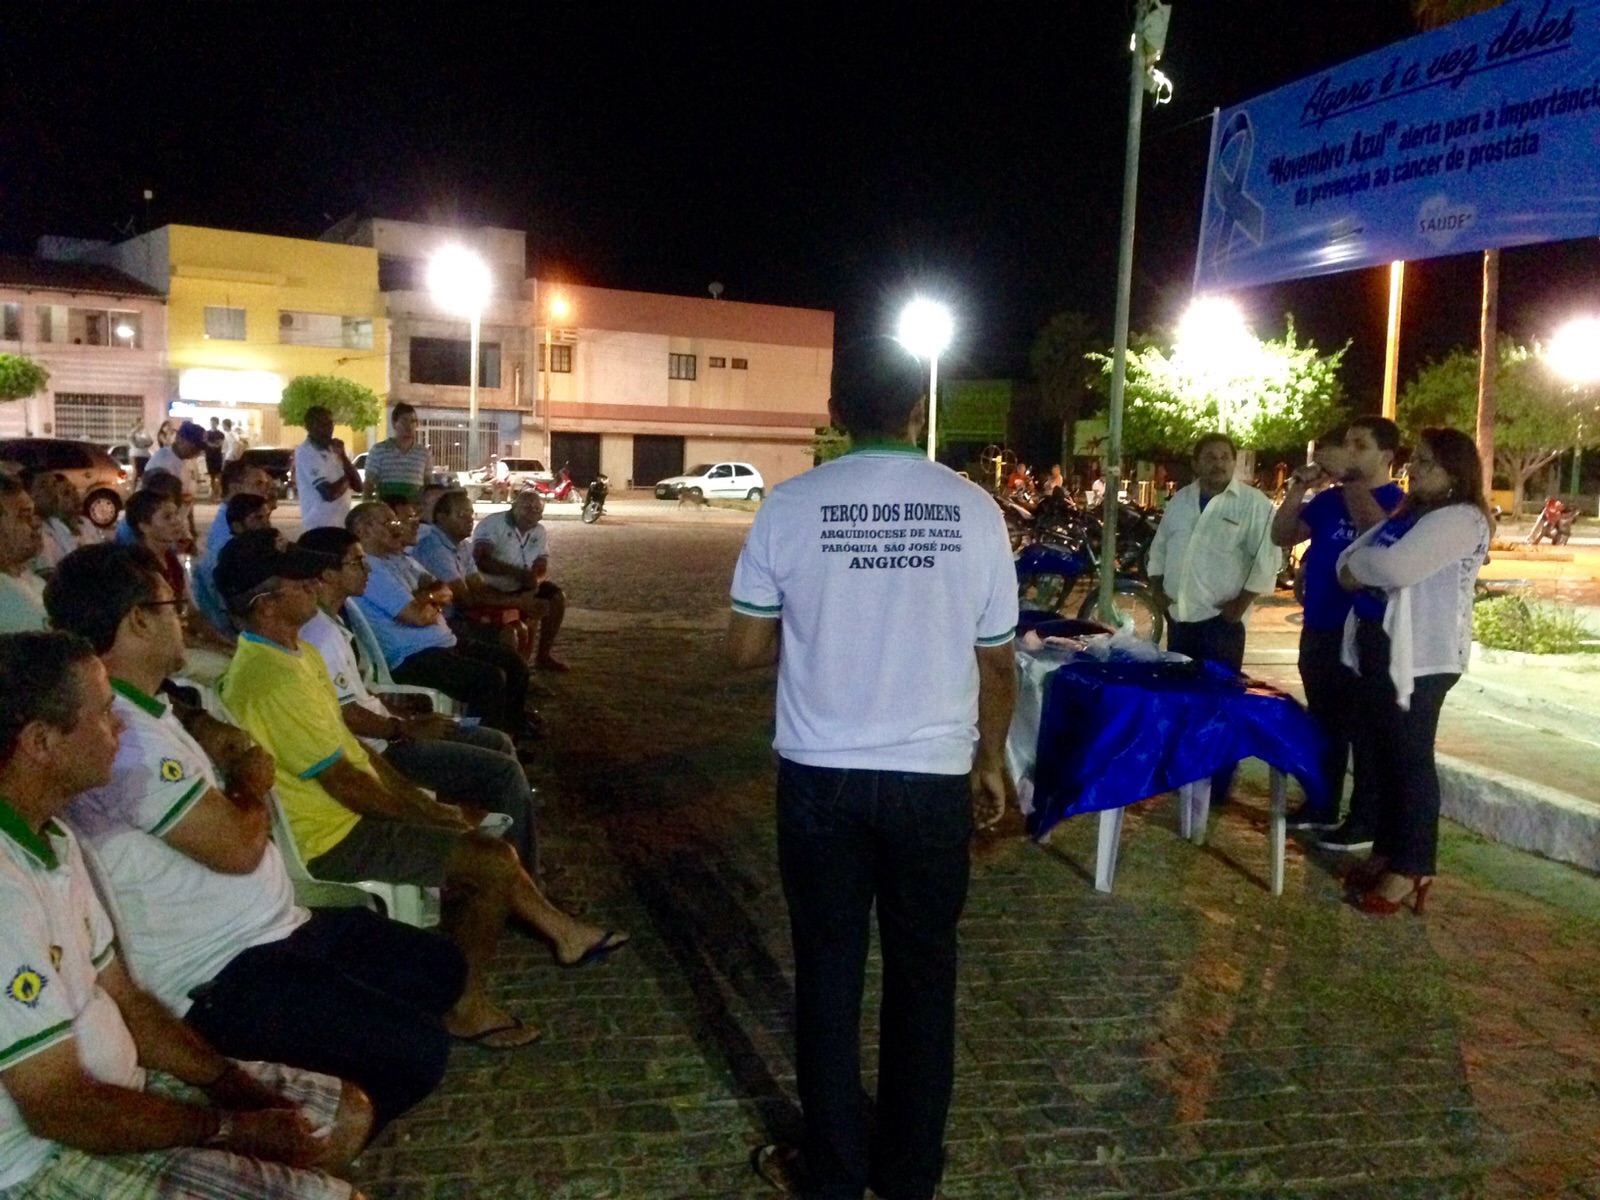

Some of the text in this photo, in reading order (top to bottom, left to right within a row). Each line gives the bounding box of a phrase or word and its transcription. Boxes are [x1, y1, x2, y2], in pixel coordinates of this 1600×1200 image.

[1301, 77, 1374, 130] Agora
[1401, 62, 1421, 87] a
[1427, 44, 1478, 89] vez
[1487, 0, 1575, 60] deles
[1398, 120, 1442, 151] alerta
[1443, 113, 1480, 146] para
[1483, 110, 1496, 131] a
[1498, 78, 1600, 130] importânci
[1373, 167, 1390, 188] ao
[1445, 145, 1465, 171] de
[821, 502, 961, 527] TERÇO DOS HOMENS
[820, 529, 962, 539] ARQUIDIOCESE DE NATAL
[908, 541, 937, 552] JOSÉ
[940, 543, 961, 552] DOS
[849, 556, 935, 569] ANGICOS
